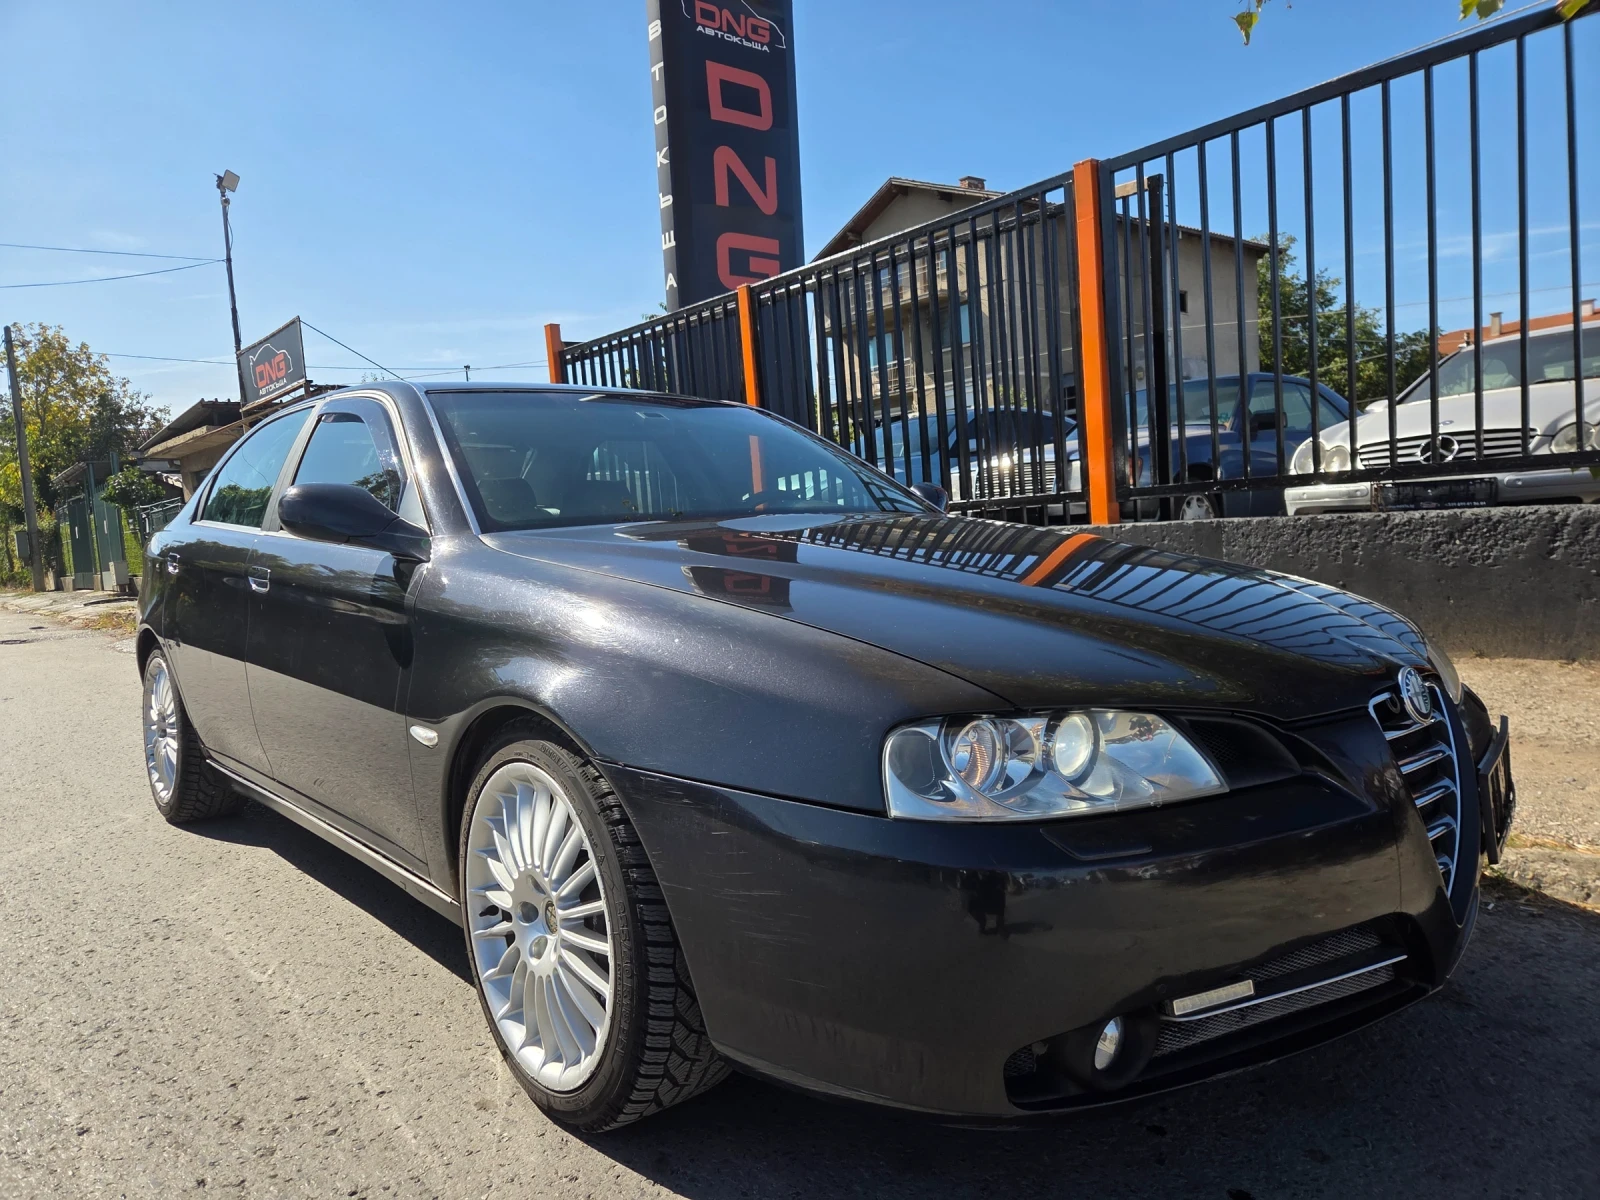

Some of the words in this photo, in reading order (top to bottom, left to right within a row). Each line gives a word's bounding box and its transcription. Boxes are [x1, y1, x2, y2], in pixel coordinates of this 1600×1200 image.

[694, 0, 771, 43] DNG
[696, 26, 770, 52] АВТОКЪЩА
[705, 60, 780, 290] DNG
[255, 353, 286, 388] DNG
